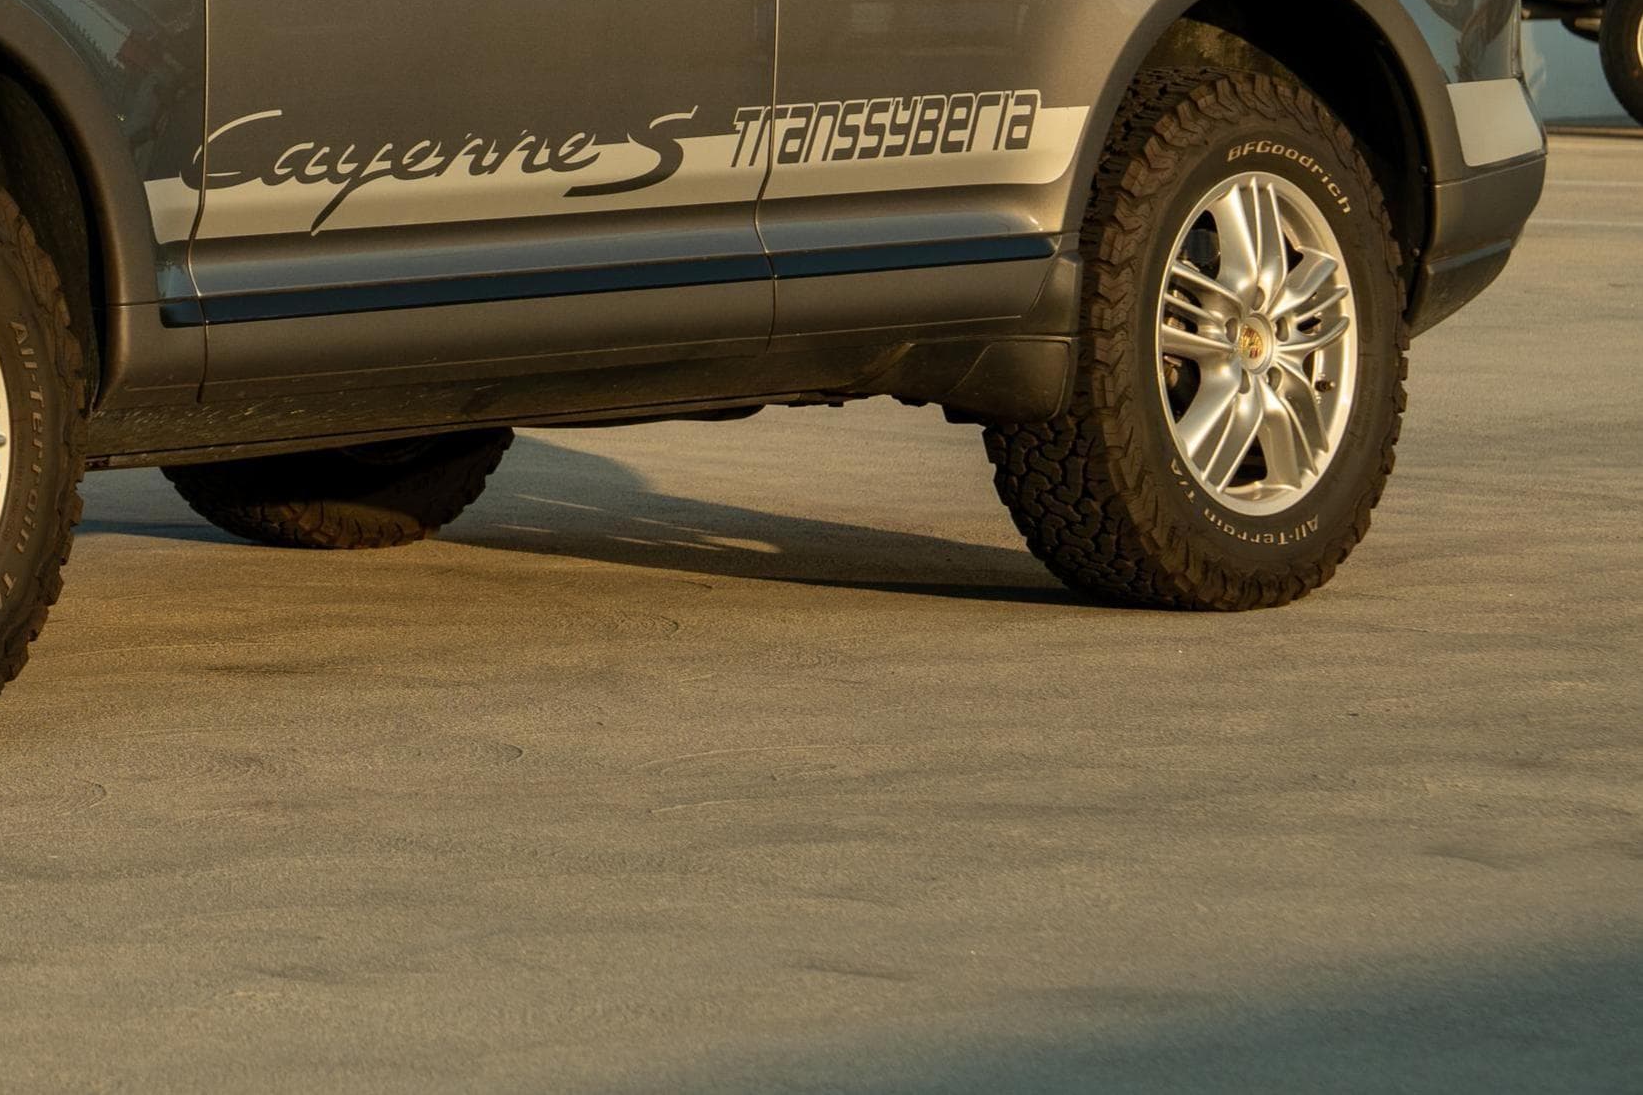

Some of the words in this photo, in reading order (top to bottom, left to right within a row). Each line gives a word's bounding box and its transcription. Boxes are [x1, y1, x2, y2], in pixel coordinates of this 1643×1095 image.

[178, 109, 602, 237] Cayenne
[562, 105, 698, 198] S
[1226, 140, 1352, 214] BFGoodrich
